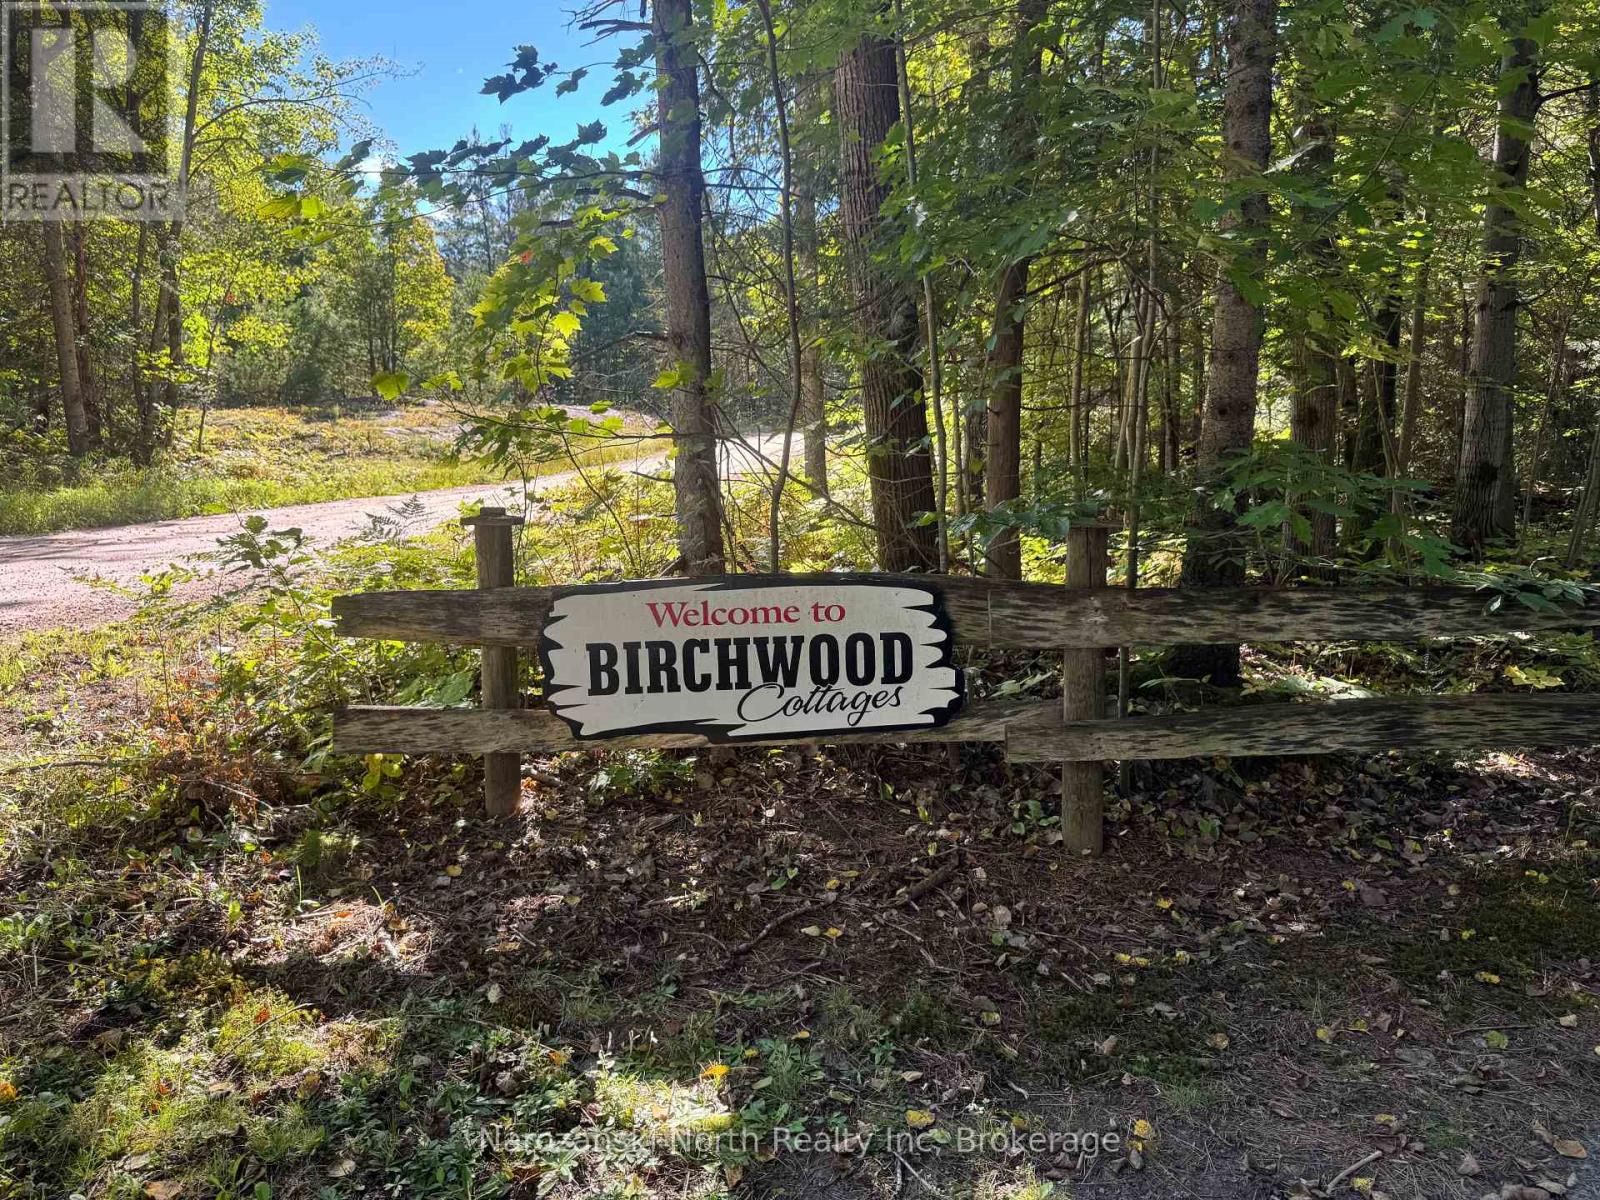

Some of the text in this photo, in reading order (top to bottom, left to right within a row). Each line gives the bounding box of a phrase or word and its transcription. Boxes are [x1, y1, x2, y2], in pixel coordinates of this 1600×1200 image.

[647, 600, 846, 628] Welcome to
[585, 631, 914, 697] BIRCHWOOD
[737, 682, 903, 727] Cottages
